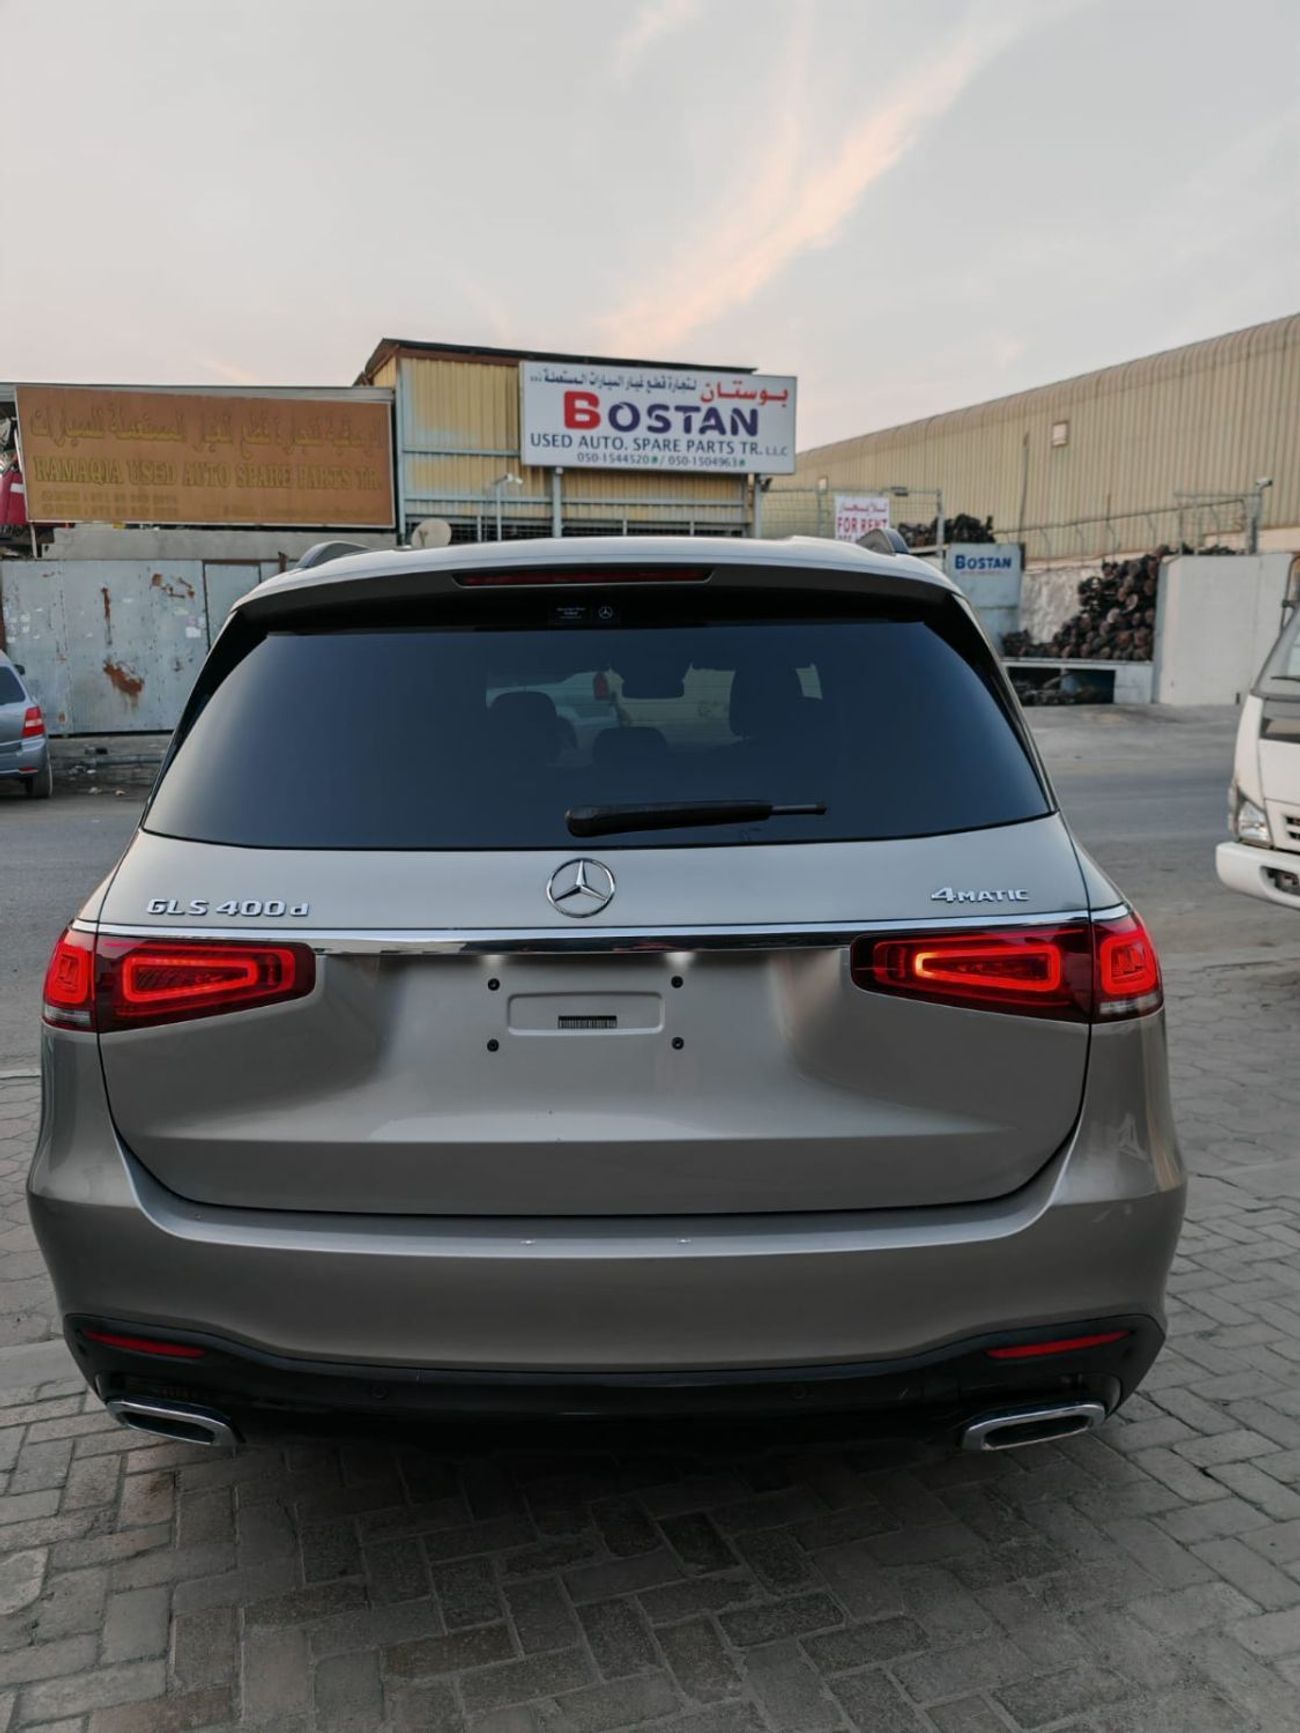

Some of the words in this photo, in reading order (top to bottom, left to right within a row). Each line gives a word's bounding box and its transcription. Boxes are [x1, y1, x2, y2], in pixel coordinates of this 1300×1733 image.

[700, 380, 789, 408] بوستان
[563, 391, 759, 436] BOSTAN
[530, 432, 573, 449] USED
[633, 437, 681, 453] SPARE
[686, 439, 735, 455] PARTS
[126, 459, 178, 486] USED
[181, 462, 231, 487] AUTO
[235, 463, 292, 489] SPARE
[296, 465, 351, 490] PARTS
[837, 517, 858, 533] FOR
[955, 555, 1012, 570] BOSTAN
[930, 887, 1031, 903] 4MATIC
[146, 899, 209, 916] GLS
